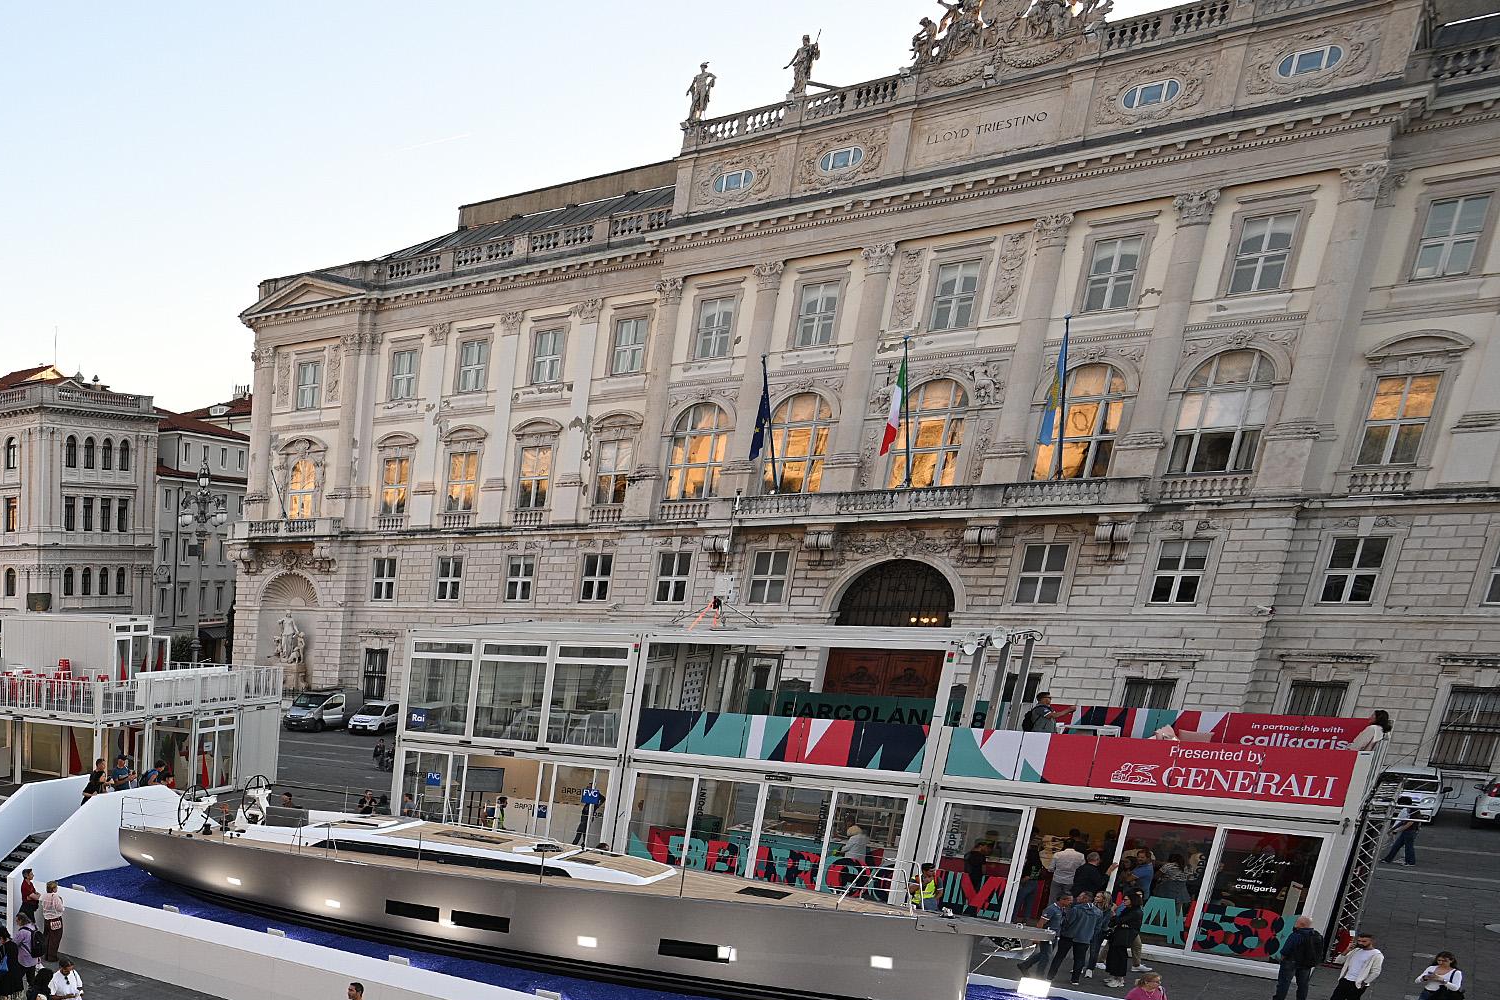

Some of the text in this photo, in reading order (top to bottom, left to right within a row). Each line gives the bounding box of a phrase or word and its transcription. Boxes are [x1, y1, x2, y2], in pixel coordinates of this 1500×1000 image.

[926, 111, 1048, 146] LLOYD TRIESTINO
[411, 713, 426, 723] Rai
[782, 700, 931, 726] BARCOLAN
[1263, 724, 1321, 734] partnership
[1323, 726, 1345, 734] with
[1169, 745, 1266, 766] Presented by
[427, 772, 441, 781] FVG
[1161, 766, 1339, 800] GENERALI
[582, 788, 600, 799] FVG
[1235, 883, 1277, 893] calligaris
